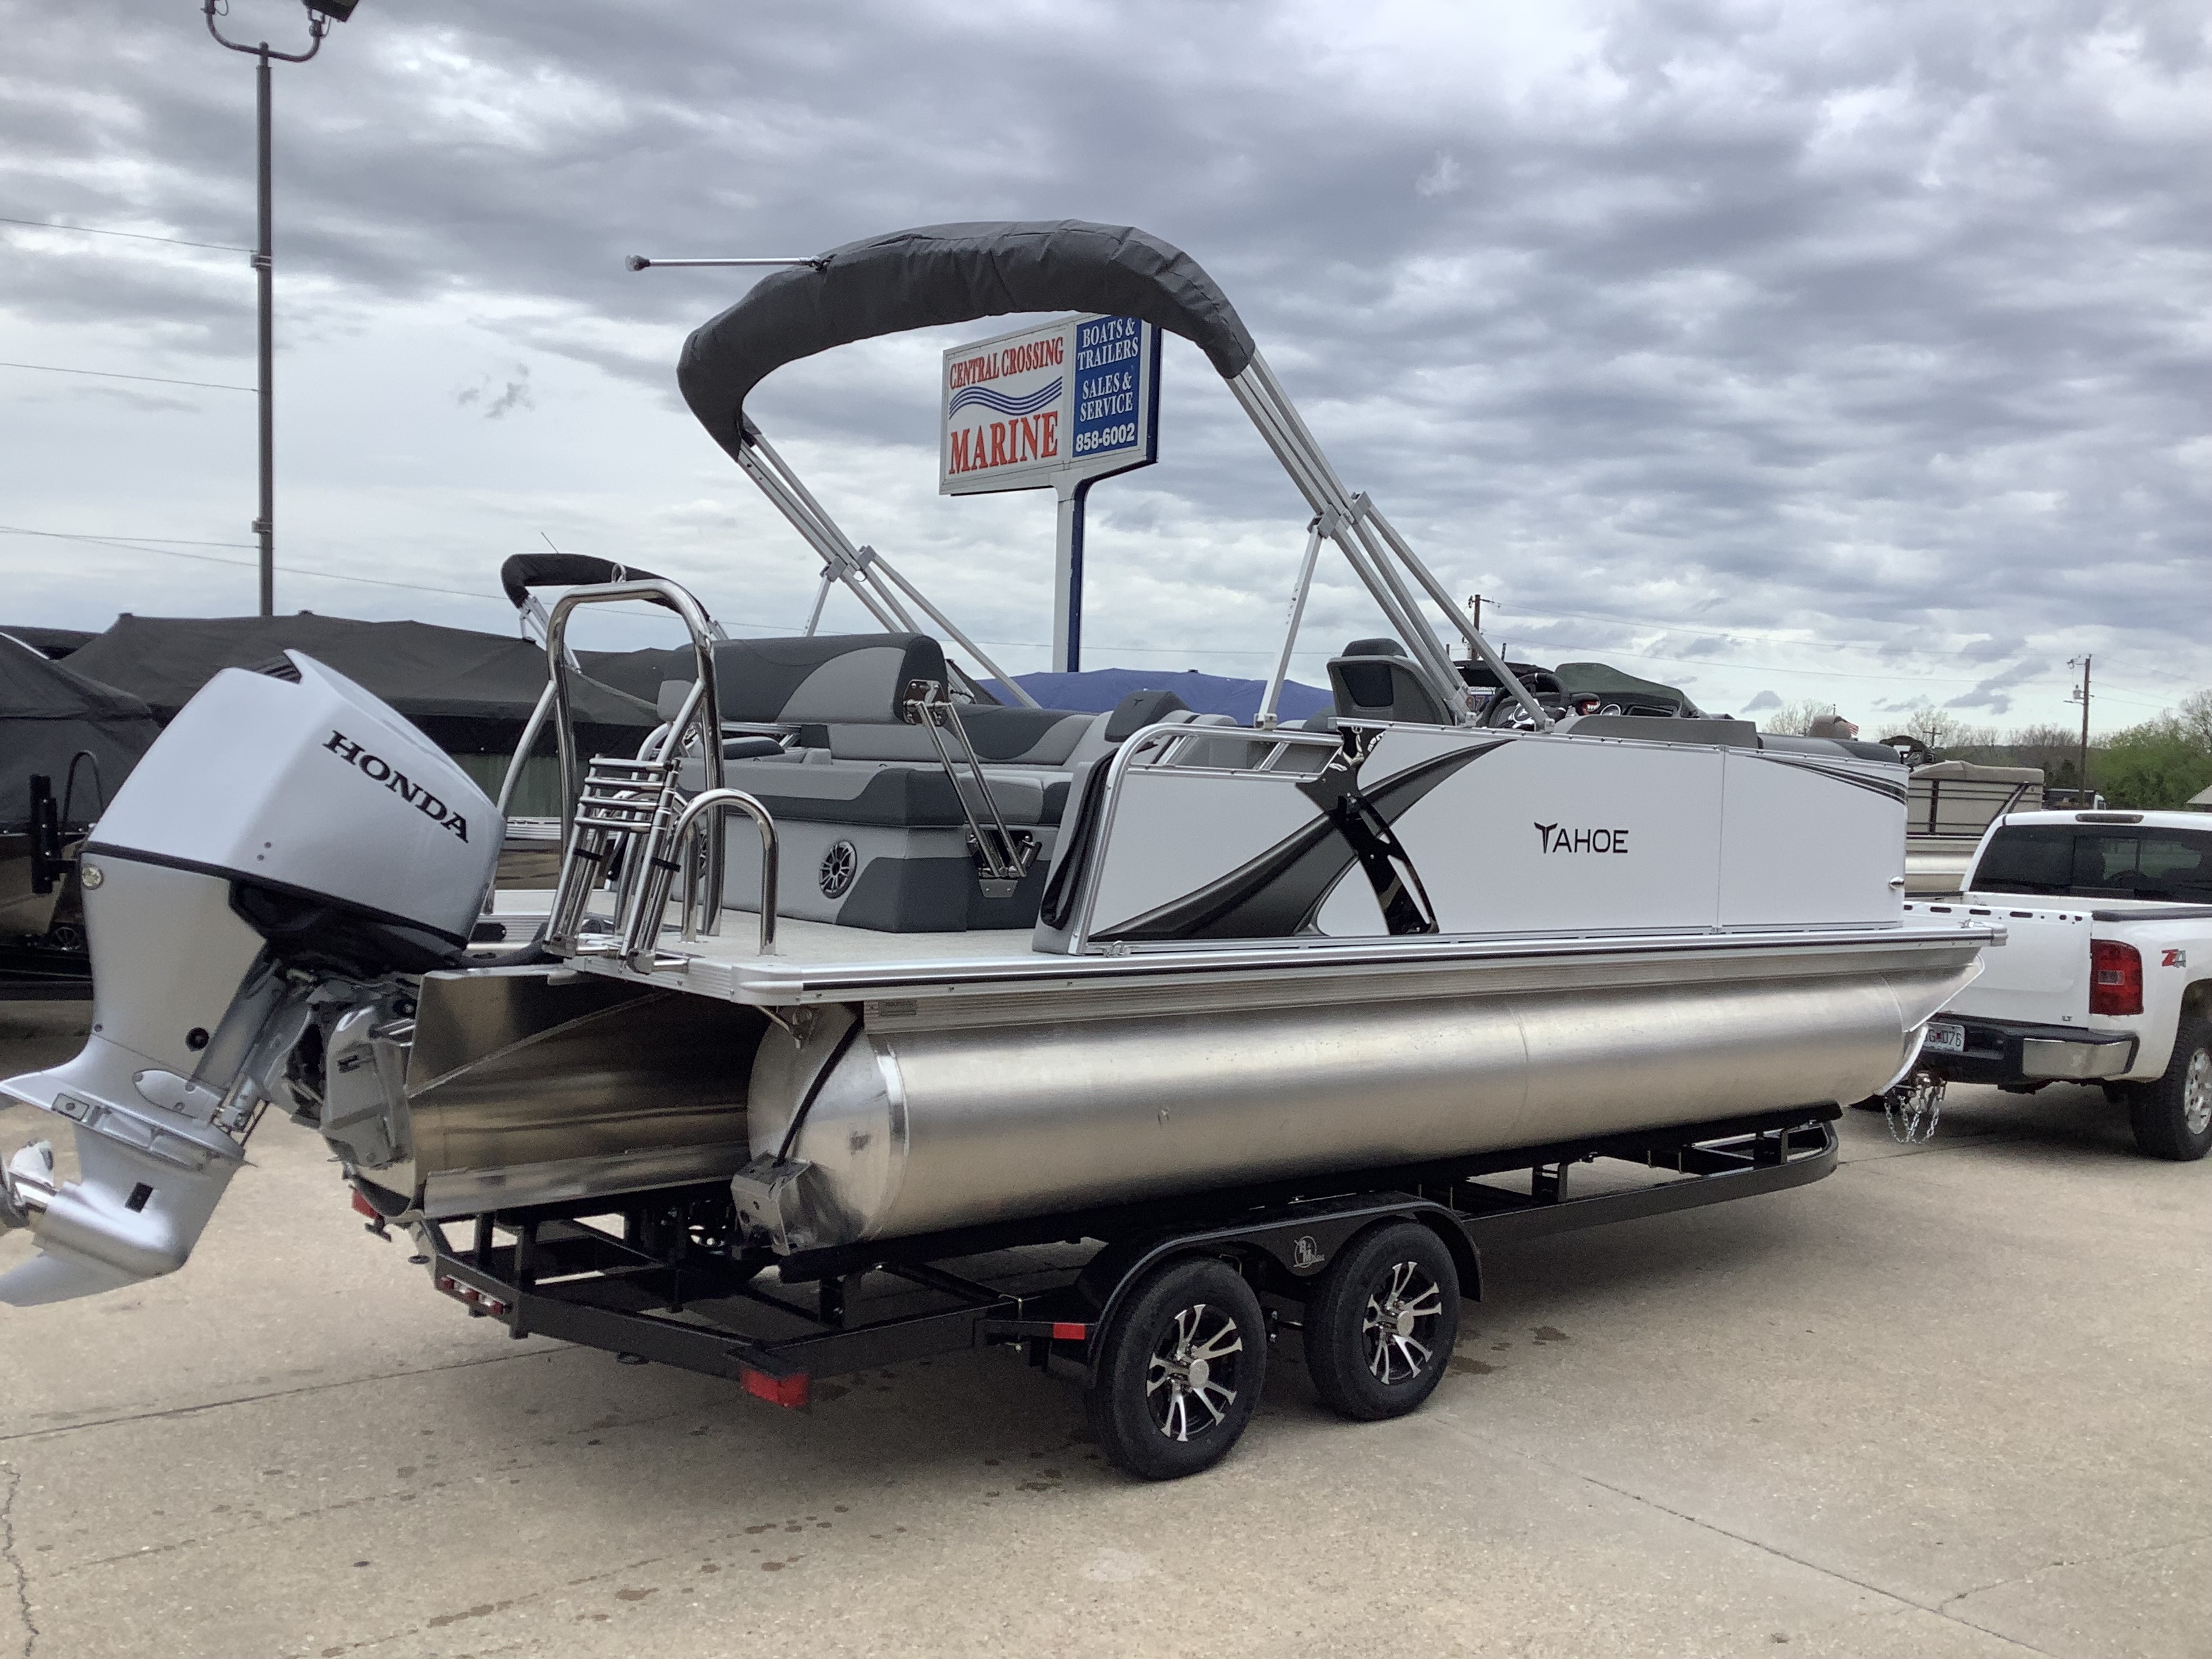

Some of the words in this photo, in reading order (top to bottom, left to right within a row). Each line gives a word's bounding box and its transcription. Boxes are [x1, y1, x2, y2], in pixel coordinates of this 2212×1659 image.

[1082, 319, 1123, 348] BOATS
[1125, 317, 1135, 337] &
[950, 352, 1000, 390] CENTRAL
[1001, 337, 1064, 377] CROSSING
[1077, 337, 1139, 371] TRAILERS
[1082, 372, 1120, 400] SALES
[1122, 371, 1132, 390] &
[1080, 392, 1133, 422] SERVICE
[949, 411, 1058, 474] MARINE
[1076, 422, 1135, 452] 858-6002
[322, 729, 469, 844] HONDA
[1534, 822, 1629, 854] TAHOE
